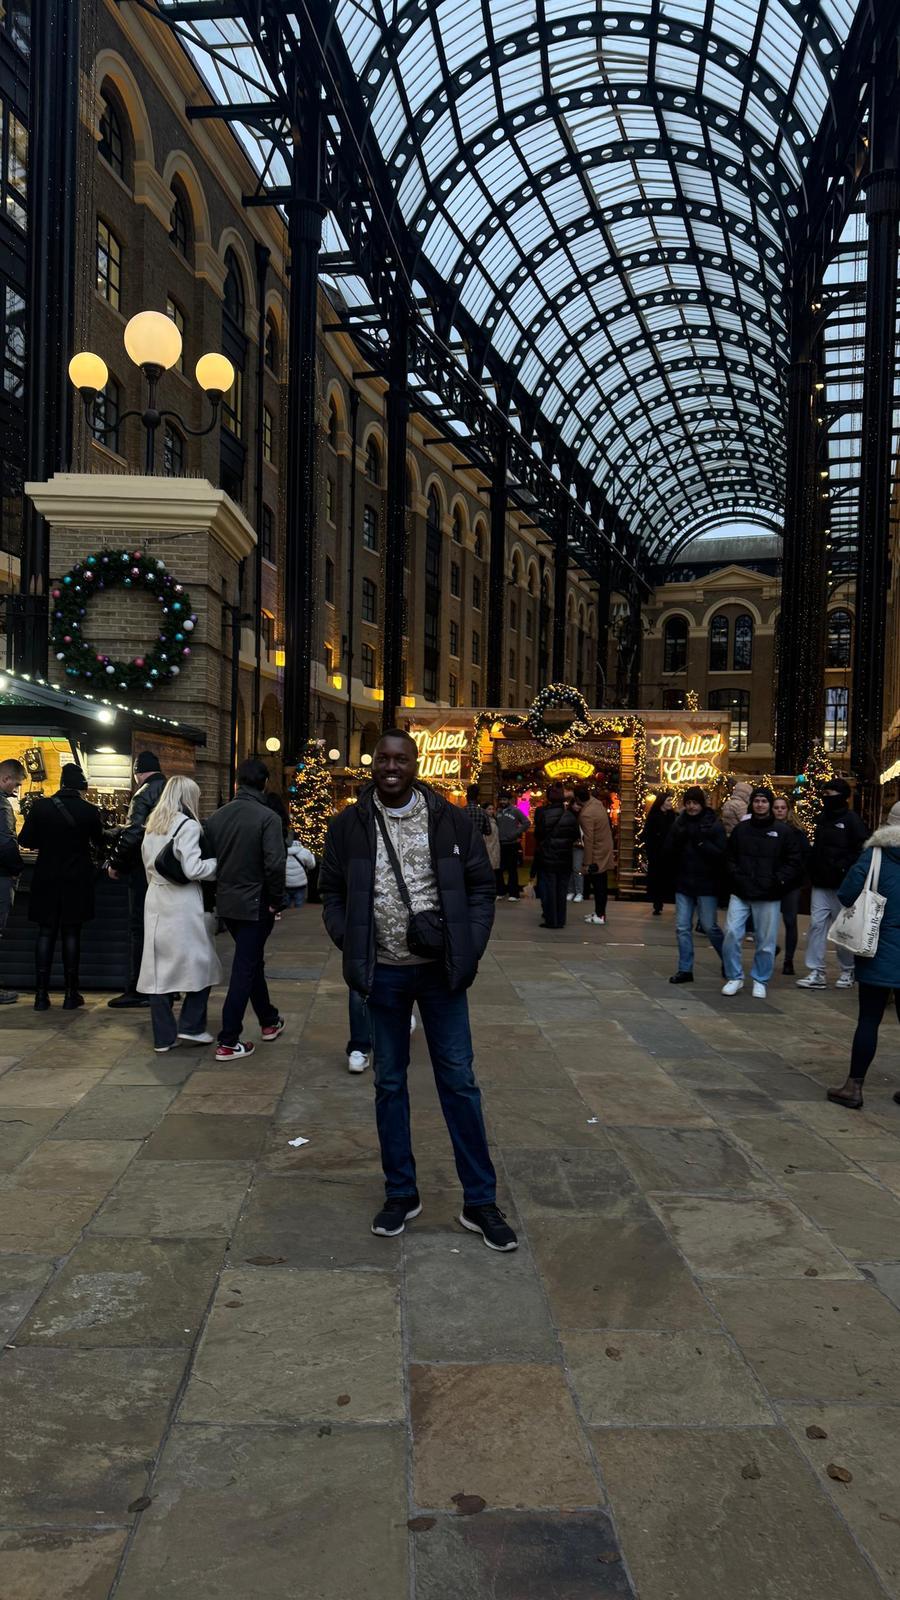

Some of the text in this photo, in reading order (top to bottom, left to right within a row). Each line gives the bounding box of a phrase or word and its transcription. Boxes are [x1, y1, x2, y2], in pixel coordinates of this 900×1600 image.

[410, 730, 468, 756] Mulled
[650, 733, 724, 761] Mulled
[416, 753, 460, 777] Wine
[549, 760, 590, 773] BAILEYS
[663, 760, 718, 784] Cider
